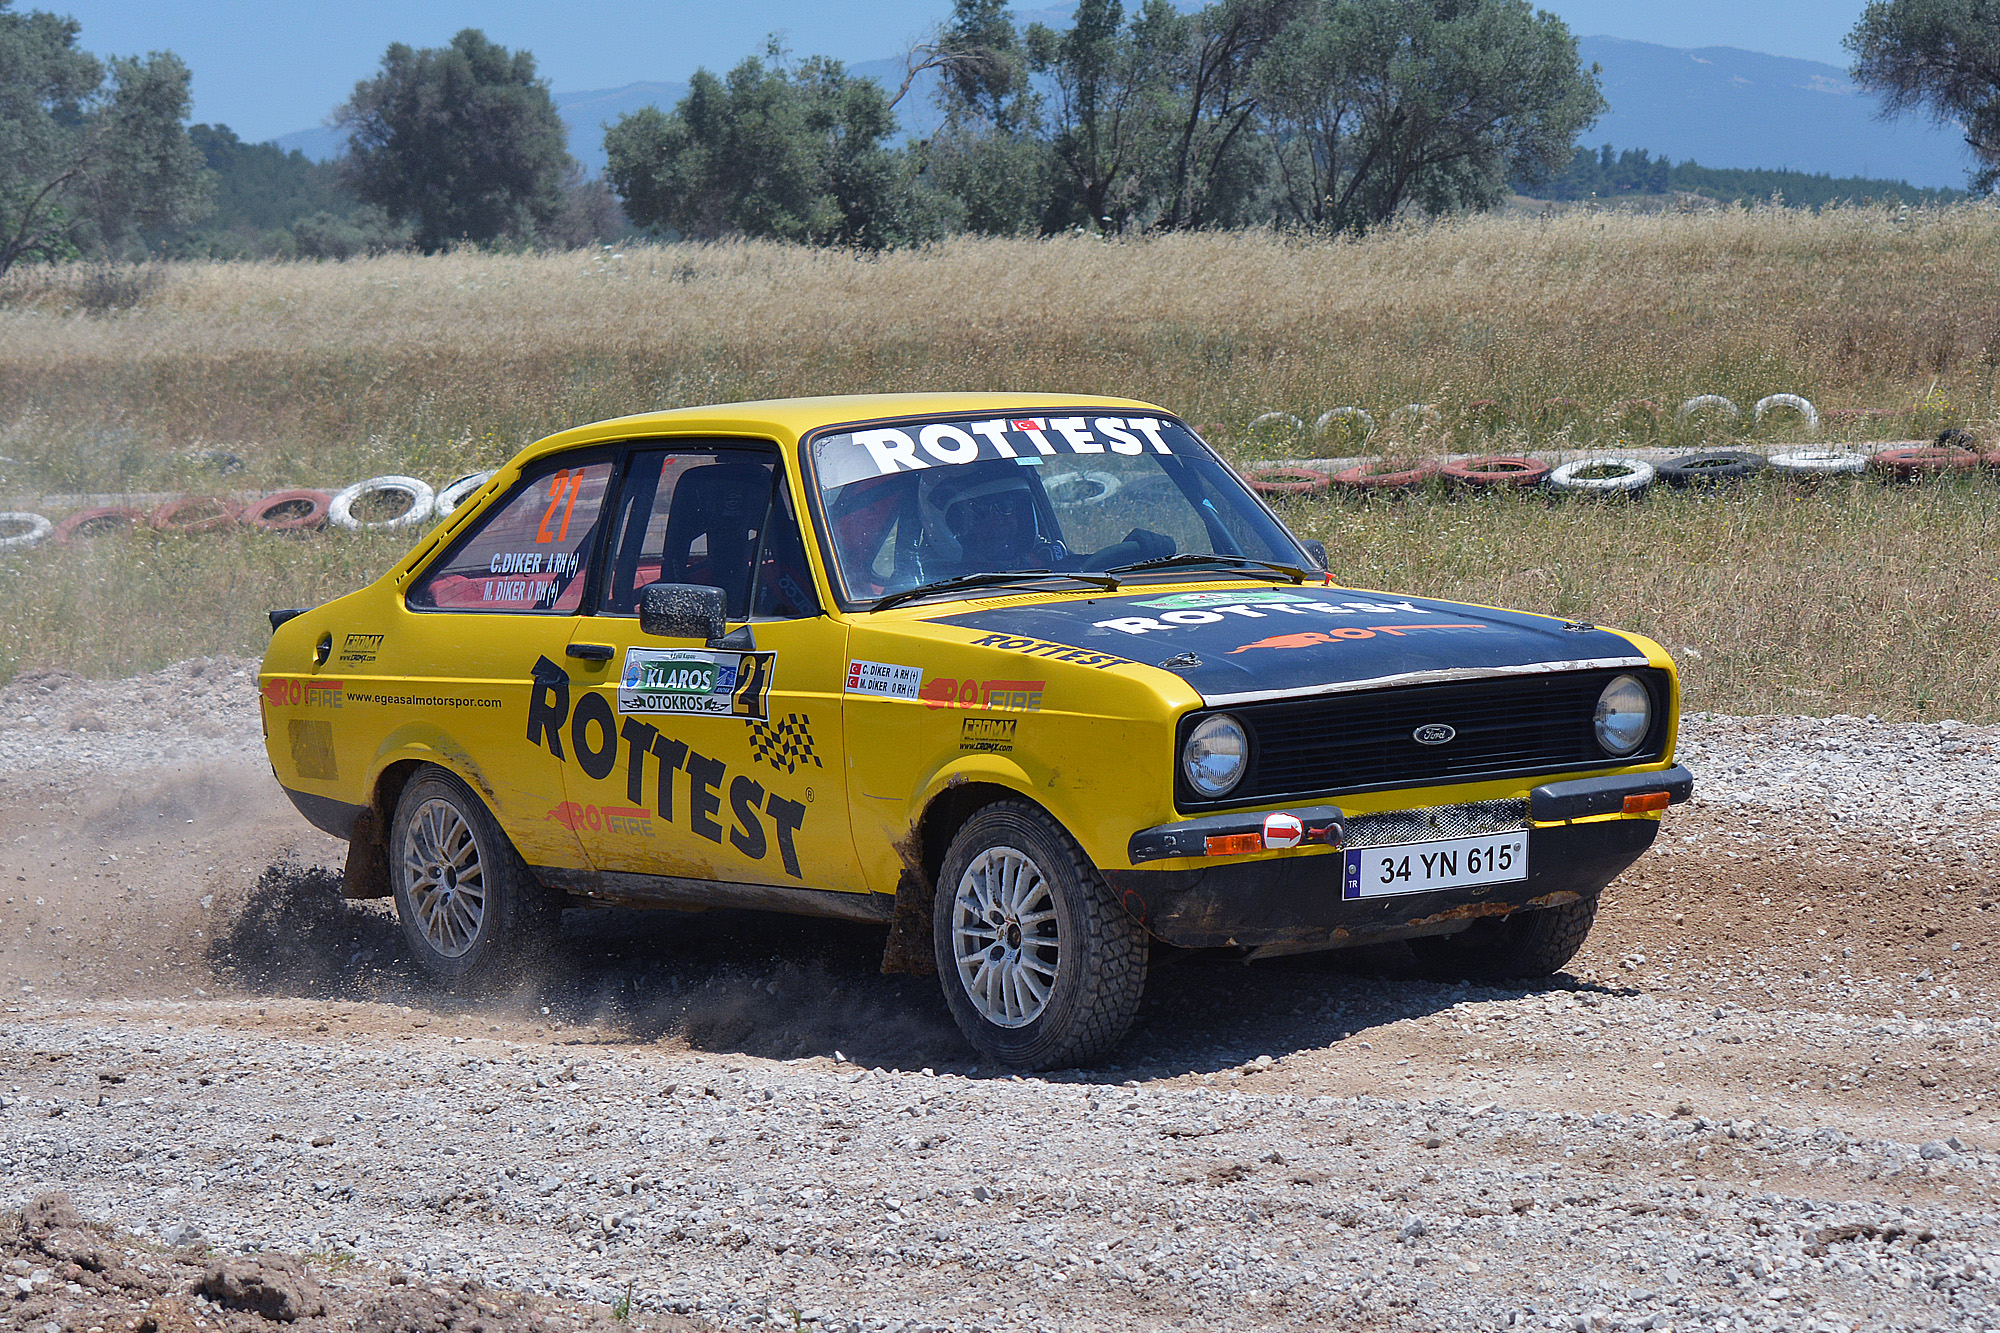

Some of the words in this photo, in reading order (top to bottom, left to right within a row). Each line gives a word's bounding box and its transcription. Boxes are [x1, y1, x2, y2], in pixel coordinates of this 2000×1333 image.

[536, 468, 585, 544] 21
[545, 553, 554, 573] A
[1092, 602, 1431, 635] ROTTEST
[970, 635, 1134, 669] ROTTEST
[644, 669, 712, 690] KLAROS
[894, 669, 899, 679] A
[733, 655, 774, 716] 21
[346, 692, 502, 708] www.egeasalmotorspor.com
[647, 695, 703, 711] OTOKROS
[1423, 728, 1445, 740] Ford
[1380, 856, 1411, 884] 34
[1420, 851, 1457, 879] YN
[1468, 844, 1512, 874] 615
[1348, 880, 1358, 888] TR
